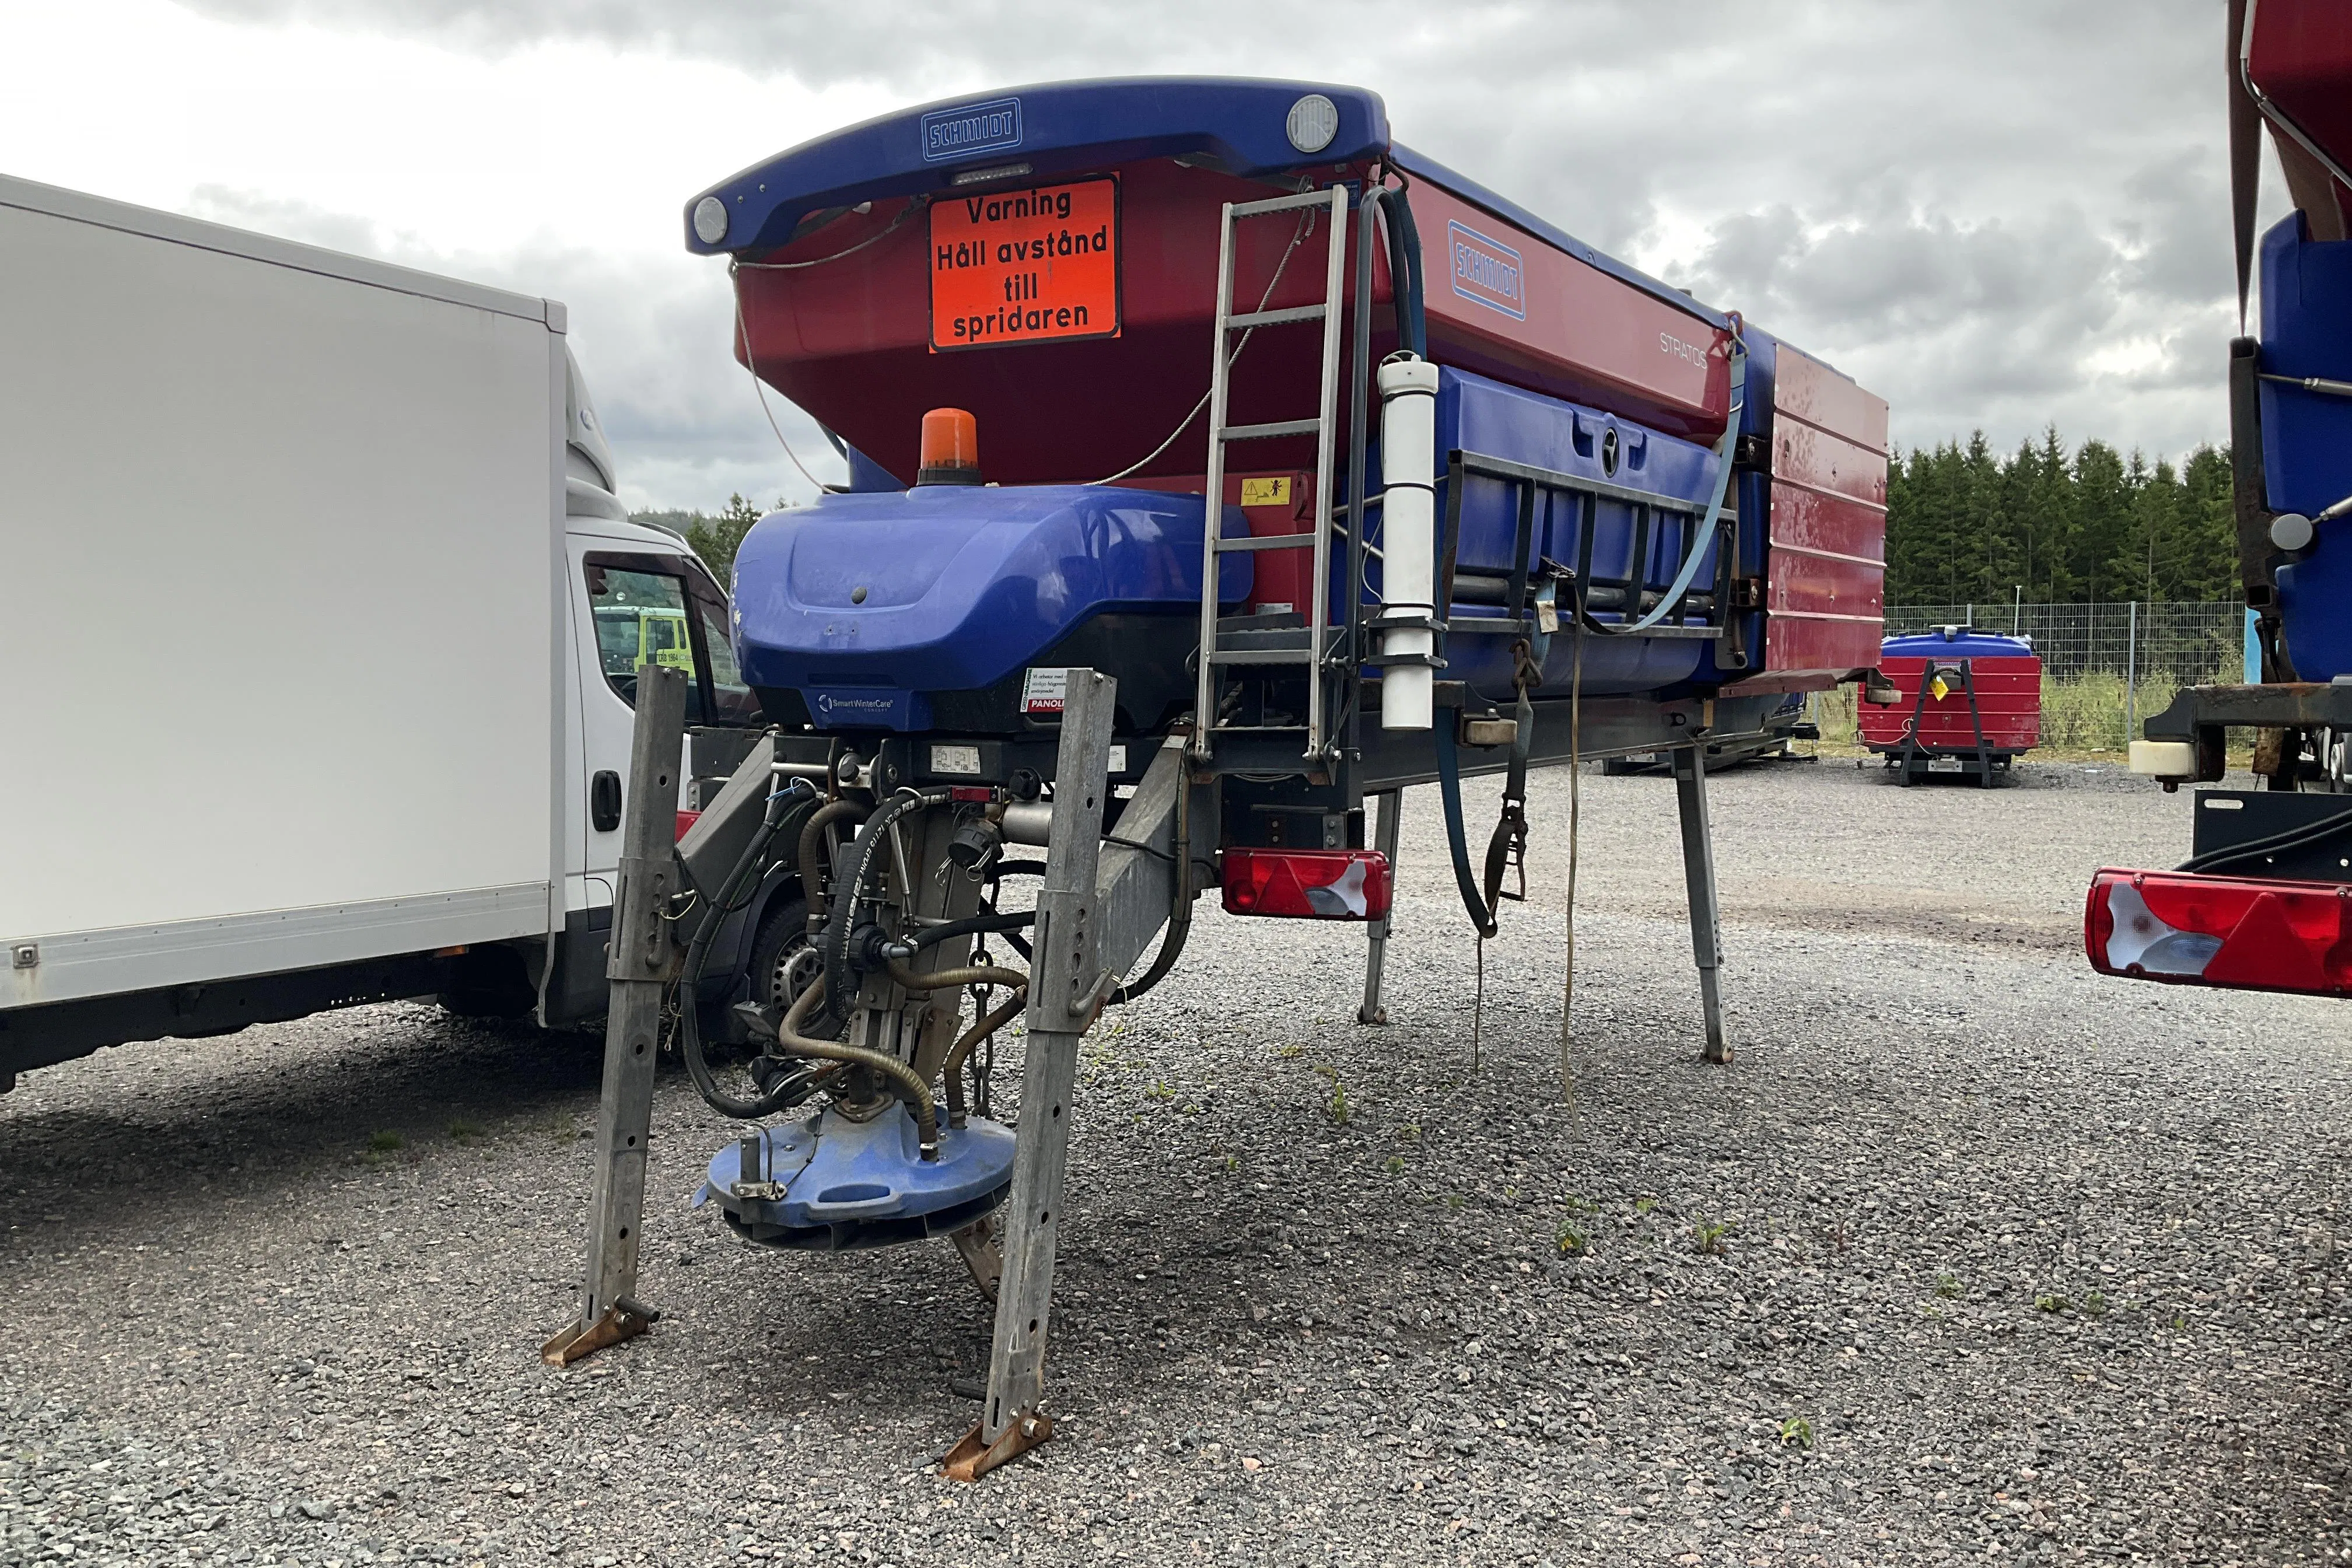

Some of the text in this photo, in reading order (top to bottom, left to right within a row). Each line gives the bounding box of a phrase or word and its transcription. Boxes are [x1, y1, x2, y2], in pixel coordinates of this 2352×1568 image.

[930, 110, 1012, 148] SCHMIDT
[966, 189, 1071, 224] Varning
[937, 225, 1107, 271] Håll avstånd
[1004, 273, 1037, 302] till
[1456, 242, 1518, 300] SCHMIDT
[953, 303, 1088, 342] spridaren
[1660, 331, 1708, 369] STRATOS
[1031, 699, 1065, 708] PANOLI
